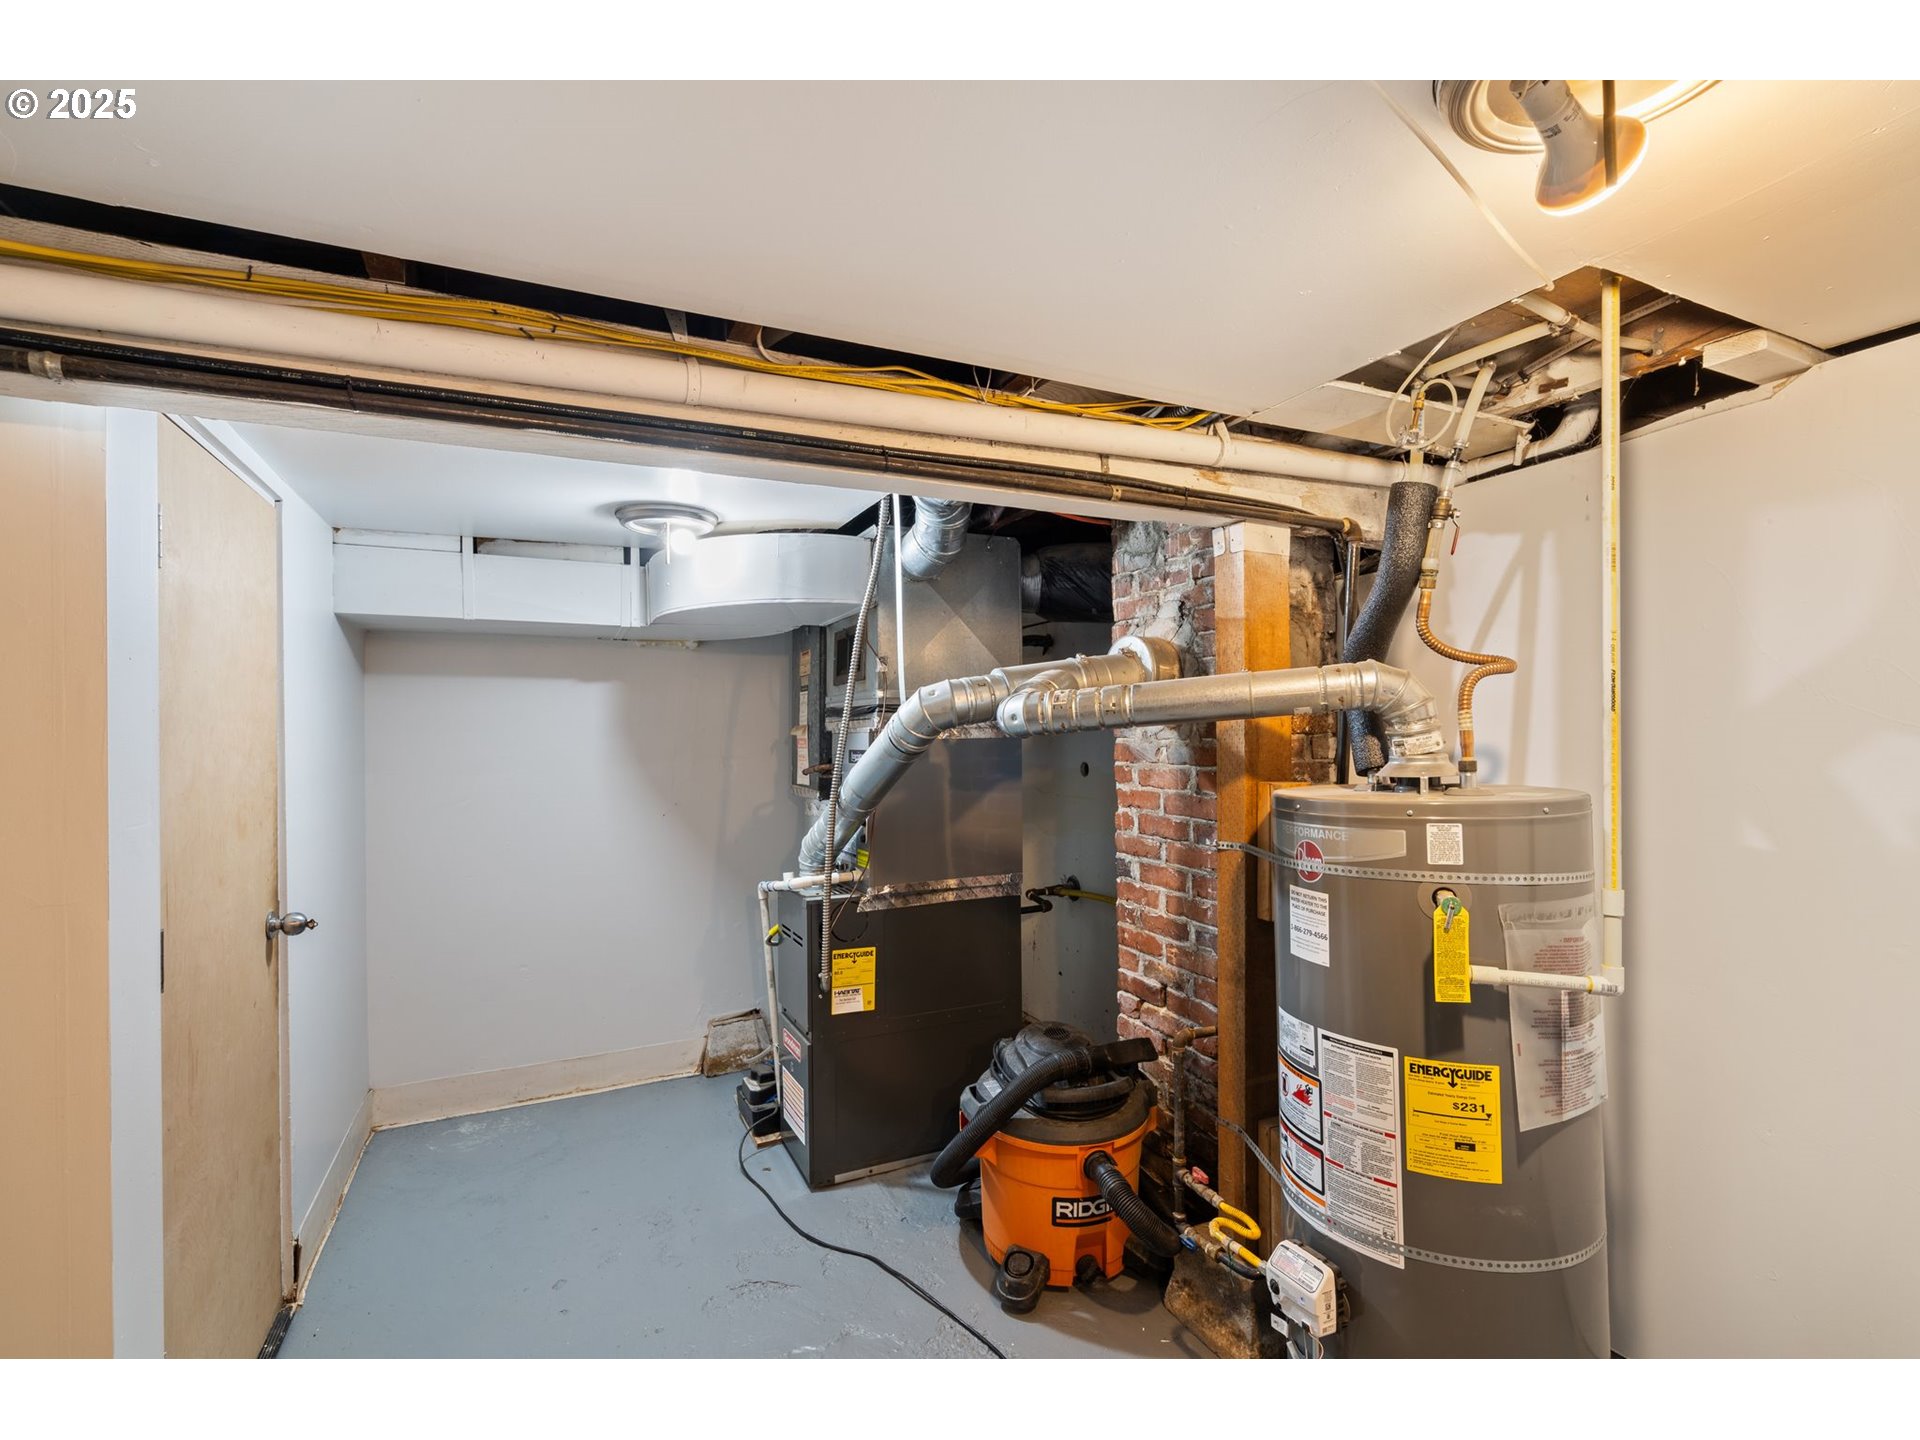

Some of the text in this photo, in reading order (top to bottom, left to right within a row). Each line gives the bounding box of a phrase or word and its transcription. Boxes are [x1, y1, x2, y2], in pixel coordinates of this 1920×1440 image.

[1283, 826, 1349, 841] PERFORMANCE
[1409, 1062, 1493, 1082] ENERGYGUIDE
[1452, 1102, 1486, 1114] $231
[1056, 1198, 1113, 1218] RIDGI
